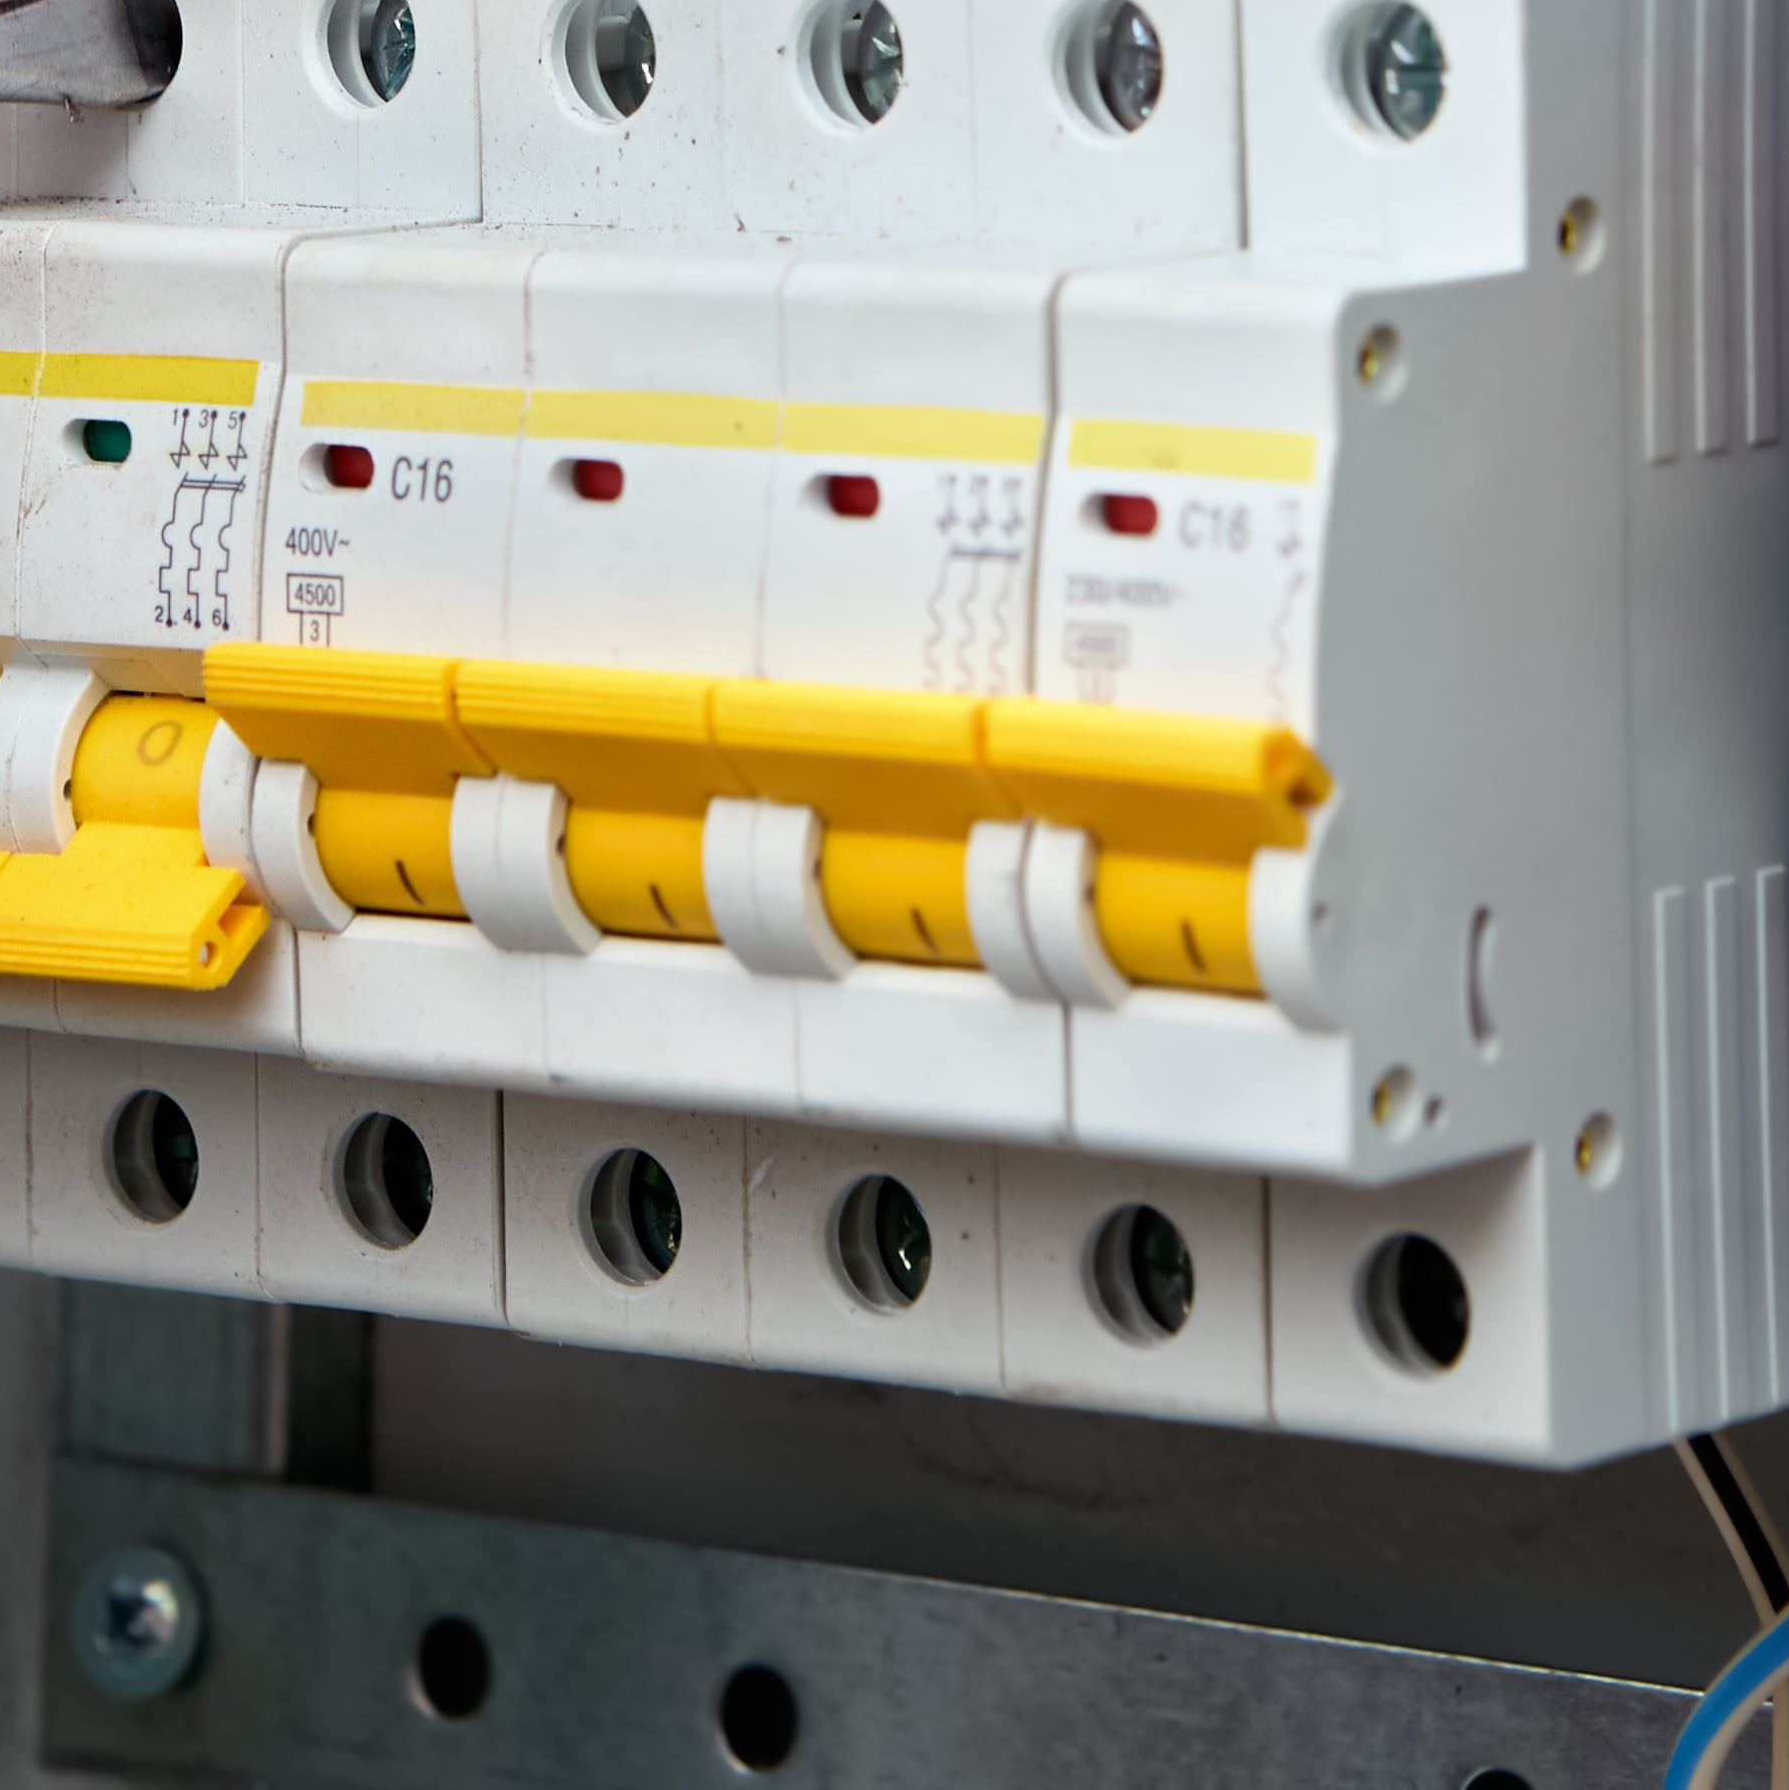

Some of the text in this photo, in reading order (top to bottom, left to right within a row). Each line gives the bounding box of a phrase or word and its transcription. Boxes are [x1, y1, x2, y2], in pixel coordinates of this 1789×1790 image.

[198, 408, 209, 428] 3
[227, 410, 238, 430] 5
[390, 455, 454, 504] C16
[1177, 499, 1252, 553] C16
[294, 581, 337, 608] 4500
[309, 619, 320, 642] 3
